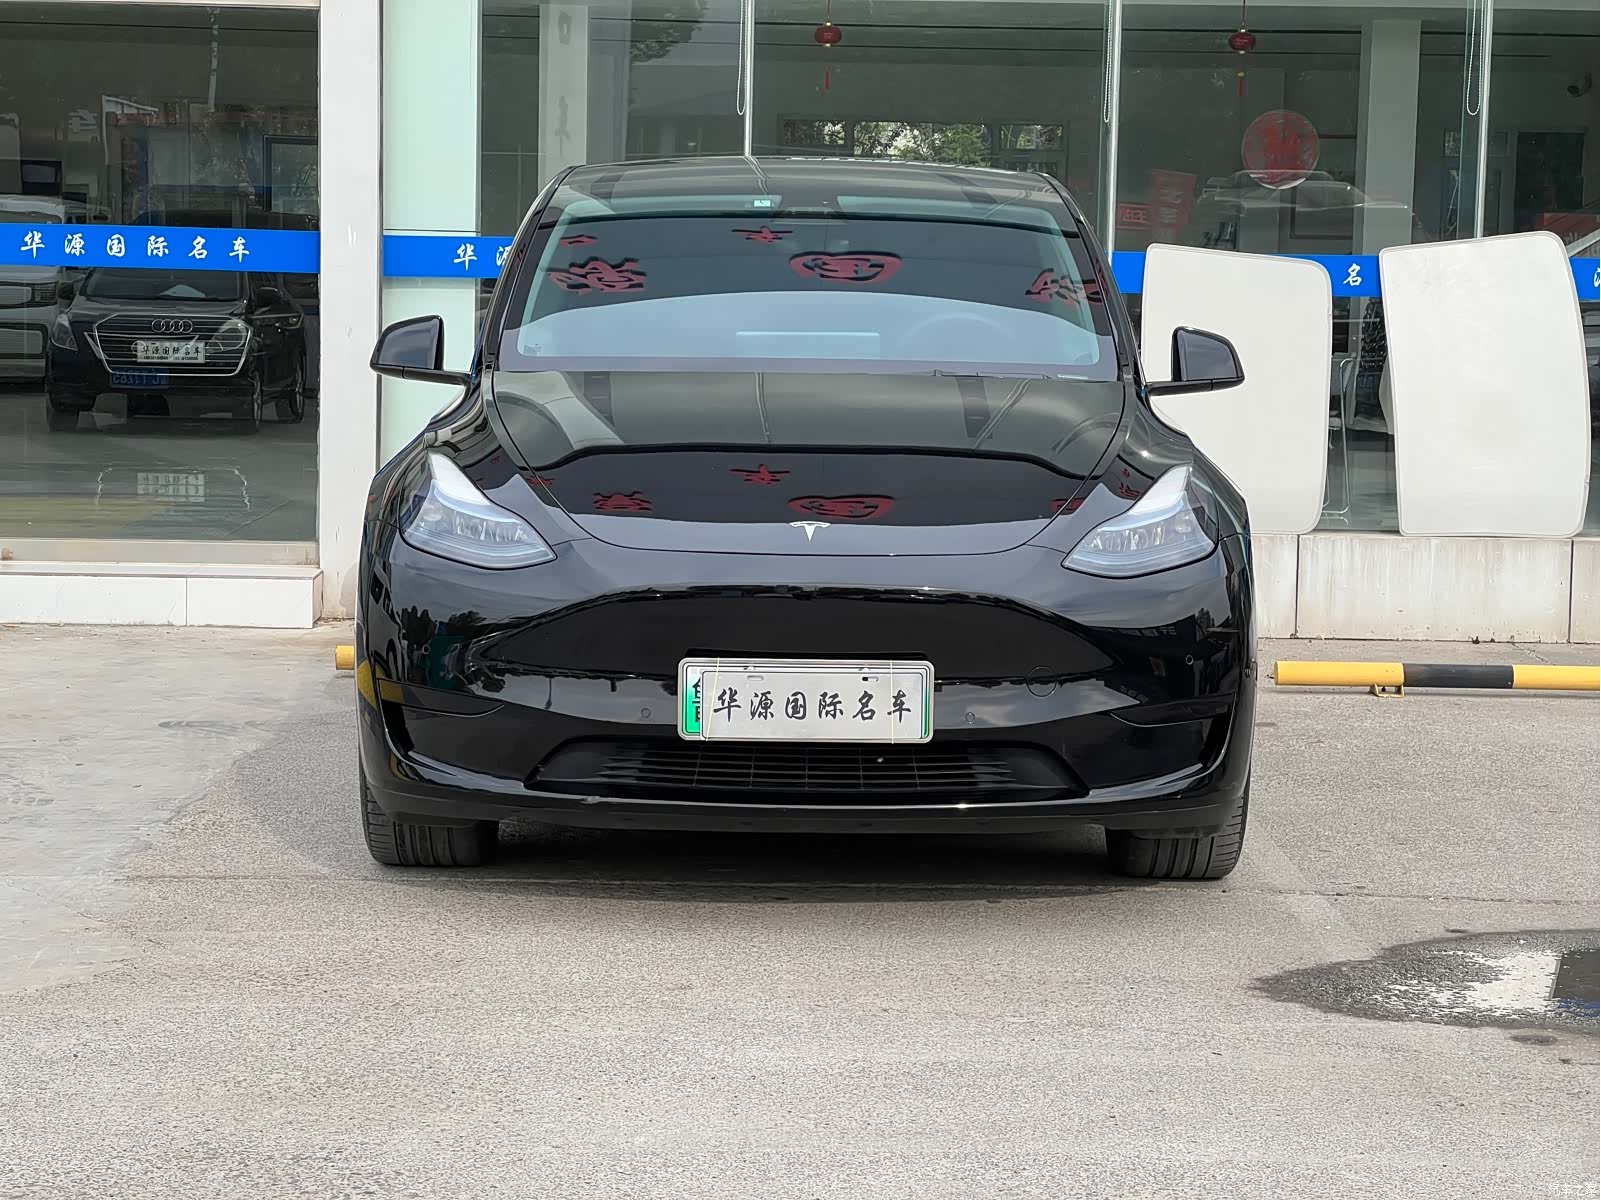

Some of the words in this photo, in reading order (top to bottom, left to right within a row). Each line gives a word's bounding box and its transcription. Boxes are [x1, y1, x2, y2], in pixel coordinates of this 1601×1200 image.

[20, 230, 250, 263] 华源国际名车
[1343, 262, 1362, 287] 名
[713, 686, 912, 724] 华源国际名车
